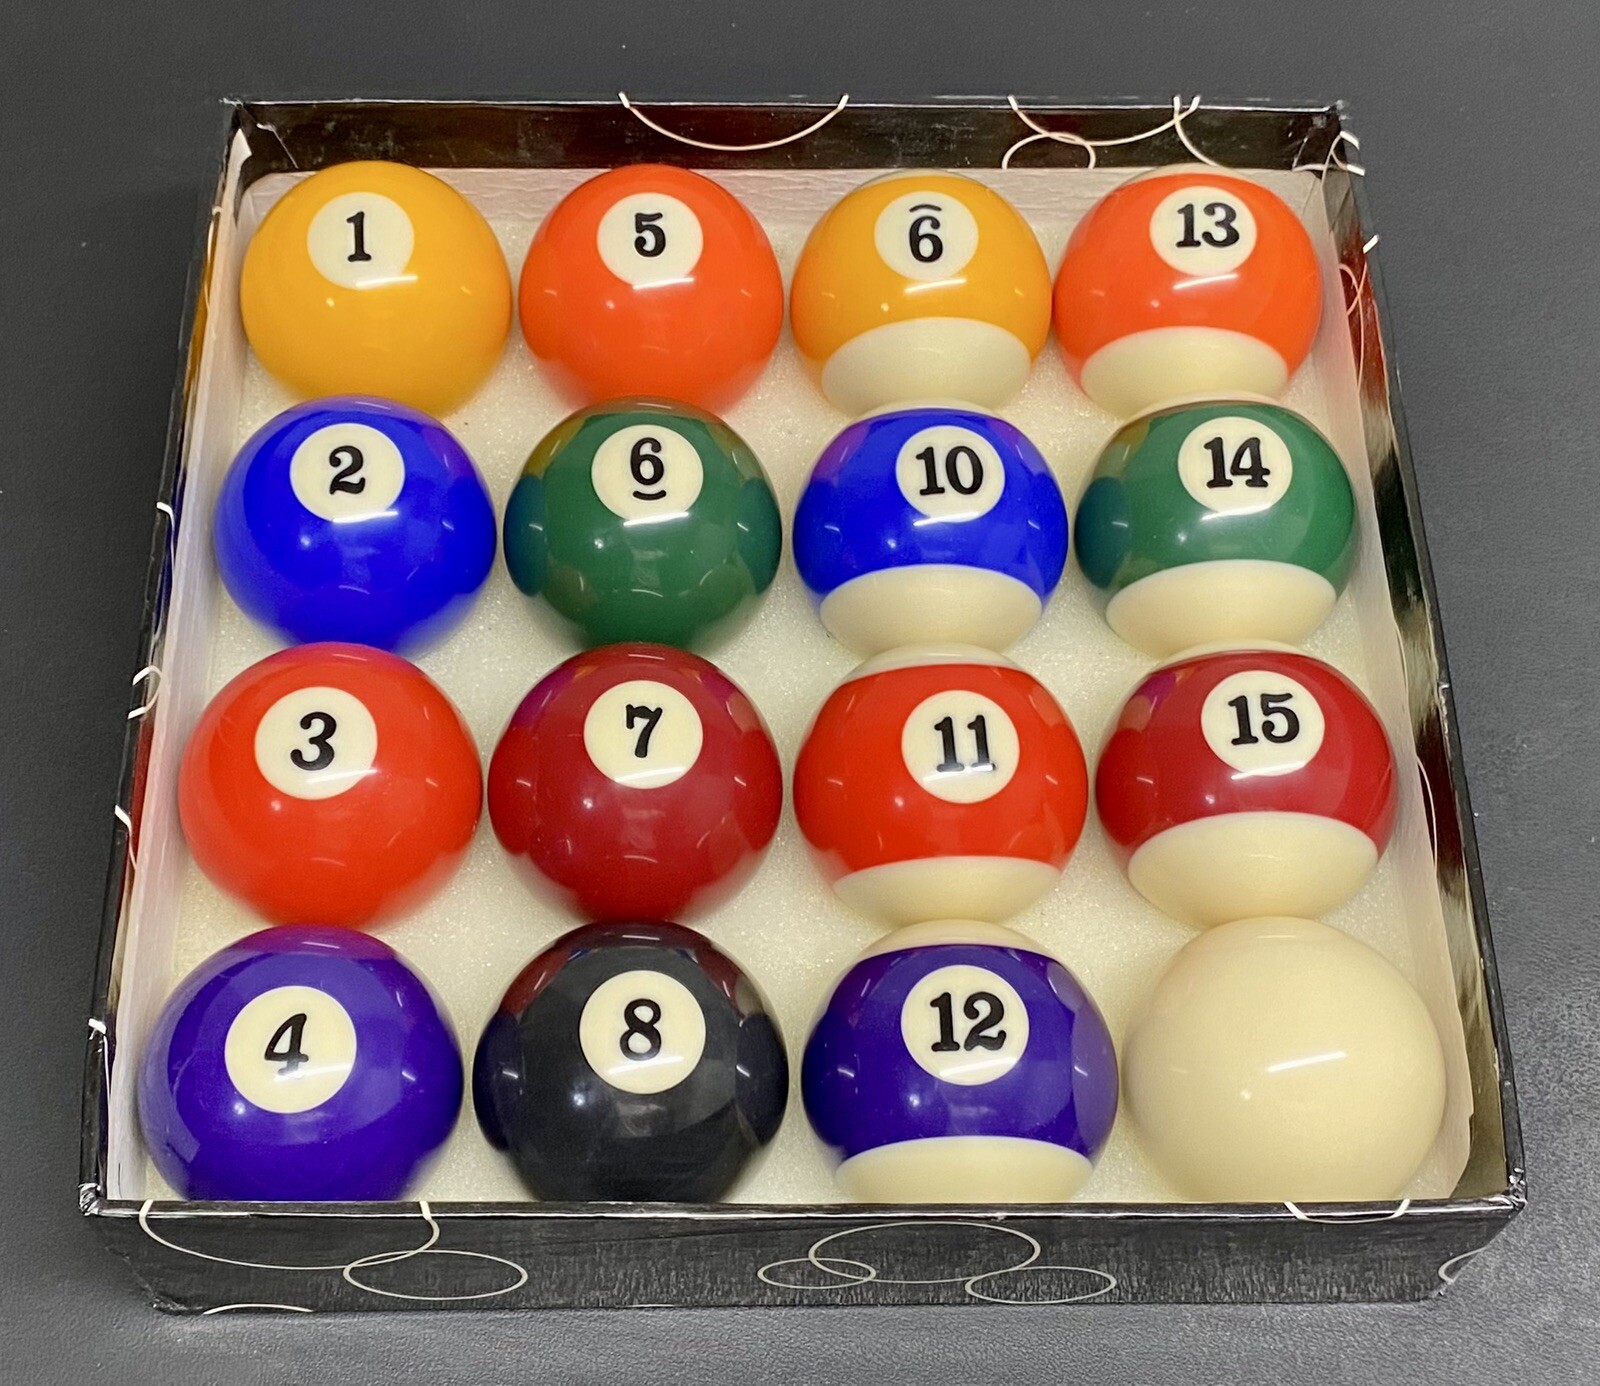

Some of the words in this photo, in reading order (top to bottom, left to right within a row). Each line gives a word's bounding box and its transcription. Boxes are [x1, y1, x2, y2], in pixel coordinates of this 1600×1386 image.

[346, 211, 372, 263] 1
[634, 212, 667, 258] 5
[1175, 202, 1240, 248] 13
[328, 445, 366, 495] 2
[629, 436, 667, 500] 6
[915, 445, 984, 497] 10
[1203, 436, 1271, 489] 14
[290, 711, 337, 771] 3
[625, 703, 663, 759] 7
[933, 714, 996, 772] 11
[1227, 692, 1300, 746] 15
[264, 1012, 309, 1077] 4
[619, 998, 662, 1060] 8
[929, 991, 1007, 1053] 12
